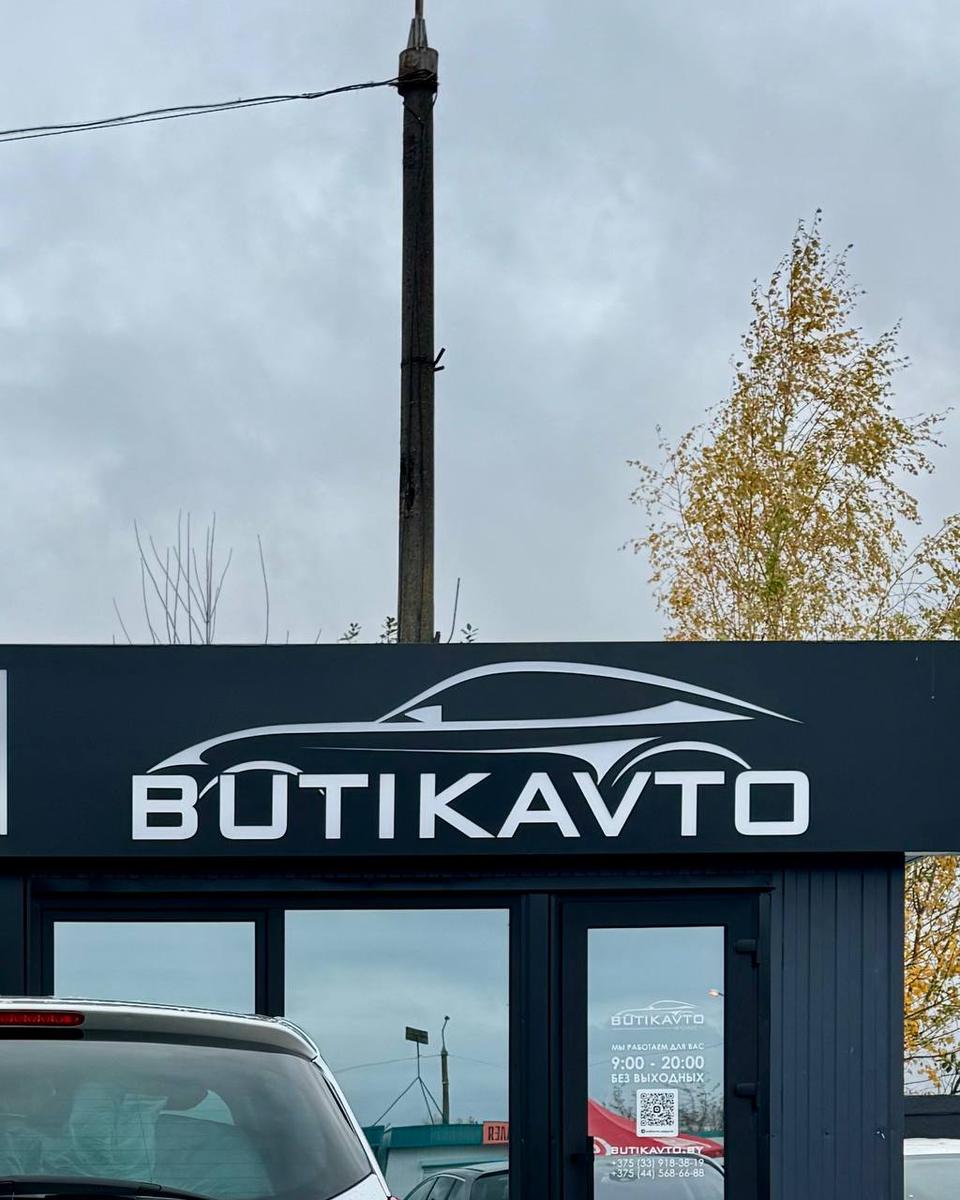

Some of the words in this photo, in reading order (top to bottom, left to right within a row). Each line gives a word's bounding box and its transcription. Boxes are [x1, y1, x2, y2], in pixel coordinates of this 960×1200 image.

[131, 769, 811, 842] BUTIKAVTO
[611, 1014, 704, 1026] BUTIKAVTO
[627, 1043, 668, 1051] РАБОТАЕМ
[670, 1043, 686, 1051] ДЛЯ
[611, 1056, 644, 1070] 9:00
[661, 1056, 705, 1069] 20:00
[611, 1073, 630, 1083] БЕЗ
[634, 1072, 704, 1084] ВЫХОДНЫХ
[611, 1146, 704, 1155] BUTIKAVTO.BY
[612, 1159, 634, 1168] +375
[637, 1159, 655, 1169] (33)
[658, 1159, 704, 1167] 918-38-19
[612, 1169, 634, 1178] +375
[637, 1168, 655, 1179] (44)
[658, 1169, 705, 1178] 568-66-88
